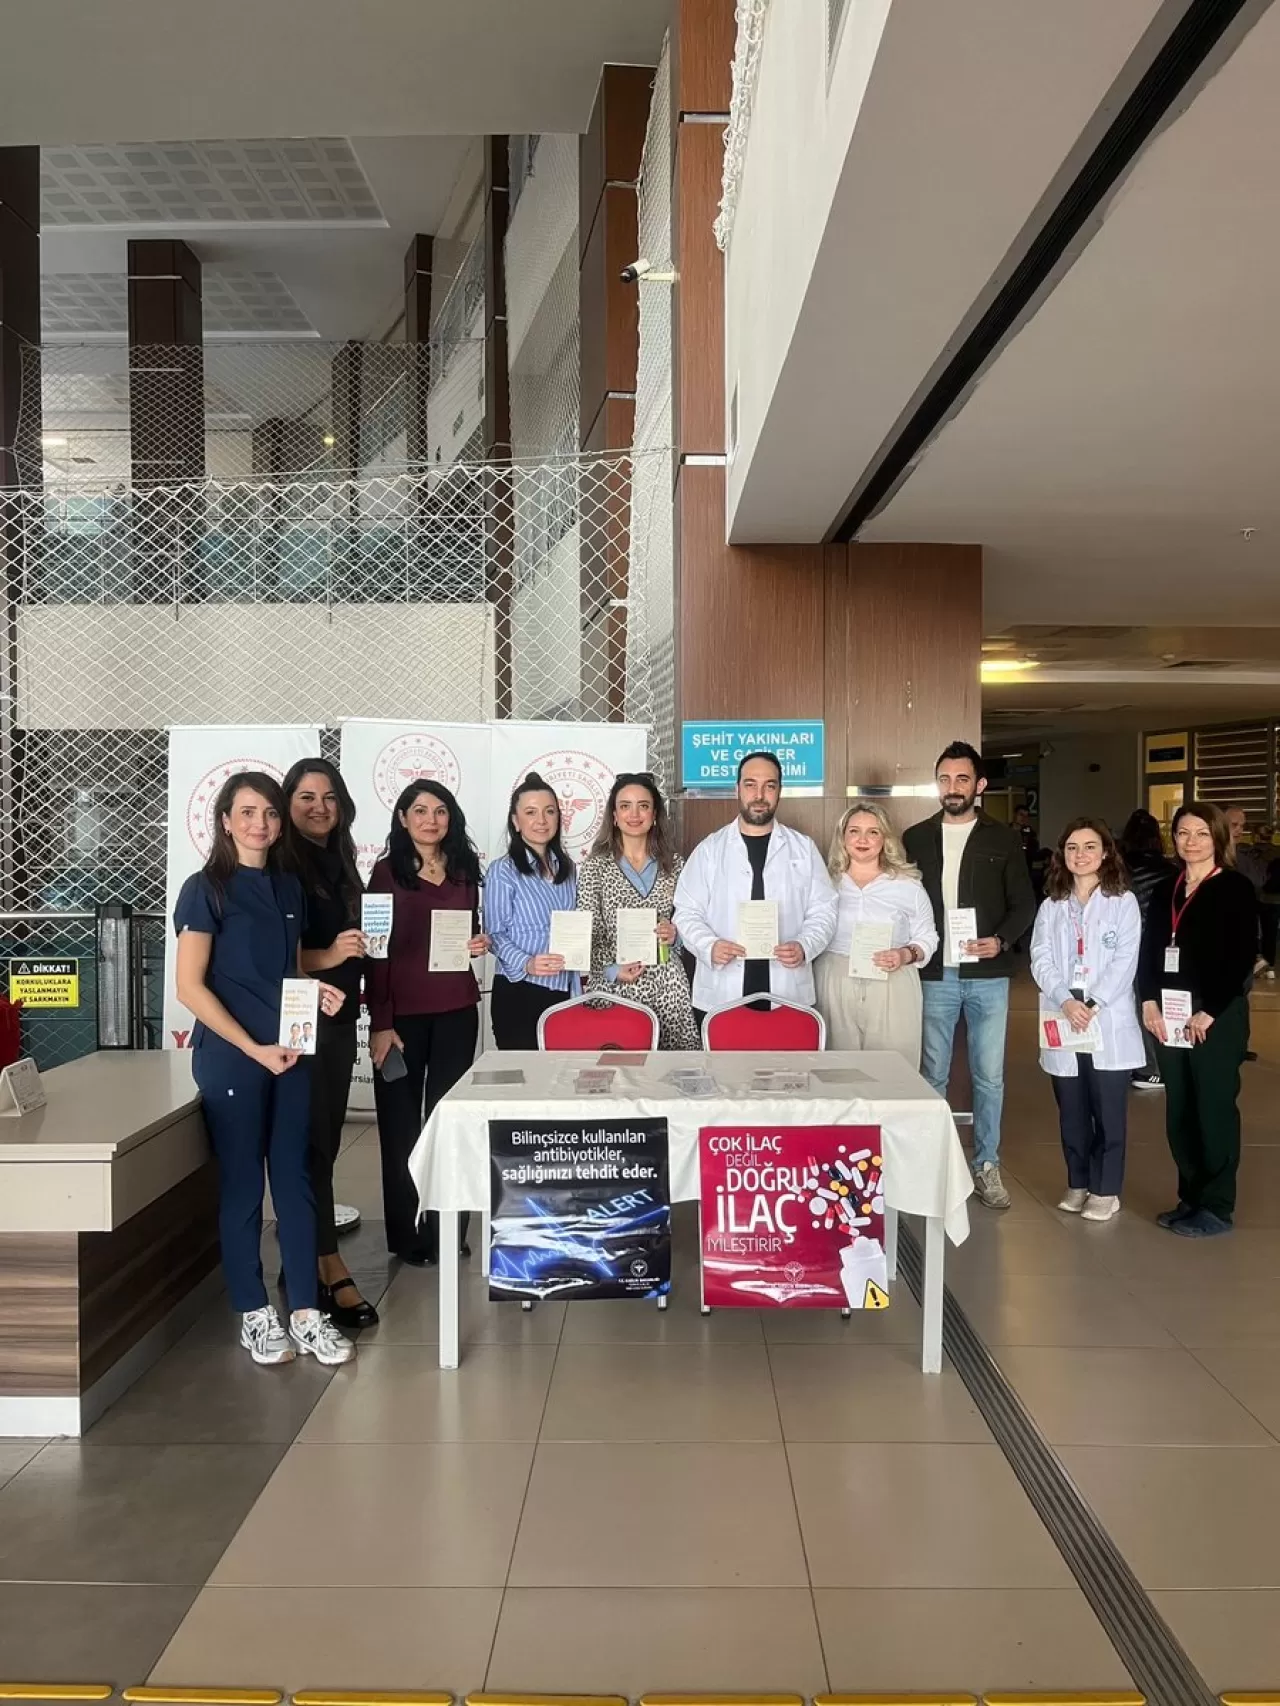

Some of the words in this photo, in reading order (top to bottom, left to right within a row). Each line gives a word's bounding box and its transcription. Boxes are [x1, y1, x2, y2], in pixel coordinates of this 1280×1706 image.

[692, 731, 734, 748] ŞEHİT
[738, 732, 814, 745] YAKINLARI
[711, 750, 729, 761] VE
[700, 765, 738, 777] DEST
[1026, 791, 1039, 814] 2
[33, 963, 71, 973] DİKKAT!
[511, 1130, 579, 1147] Bilinçsizce
[582, 1129, 646, 1144] kullanılan
[708, 1136, 743, 1155] ÇOK
[745, 1133, 782, 1154] İLAÇ
[533, 1146, 625, 1164] antibiyotikler,
[726, 1152, 762, 1167] DEĞİL
[501, 1164, 572, 1183] sağlığınızı
[575, 1163, 619, 1179] tehdit
[622, 1162, 658, 1178] eder.
[727, 1161, 808, 1192] DOĞRU
[587, 1189, 653, 1219] ALERT
[716, 1185, 797, 1244] İLAÇ
[707, 1234, 782, 1255] İYİLEŞTİRİR
